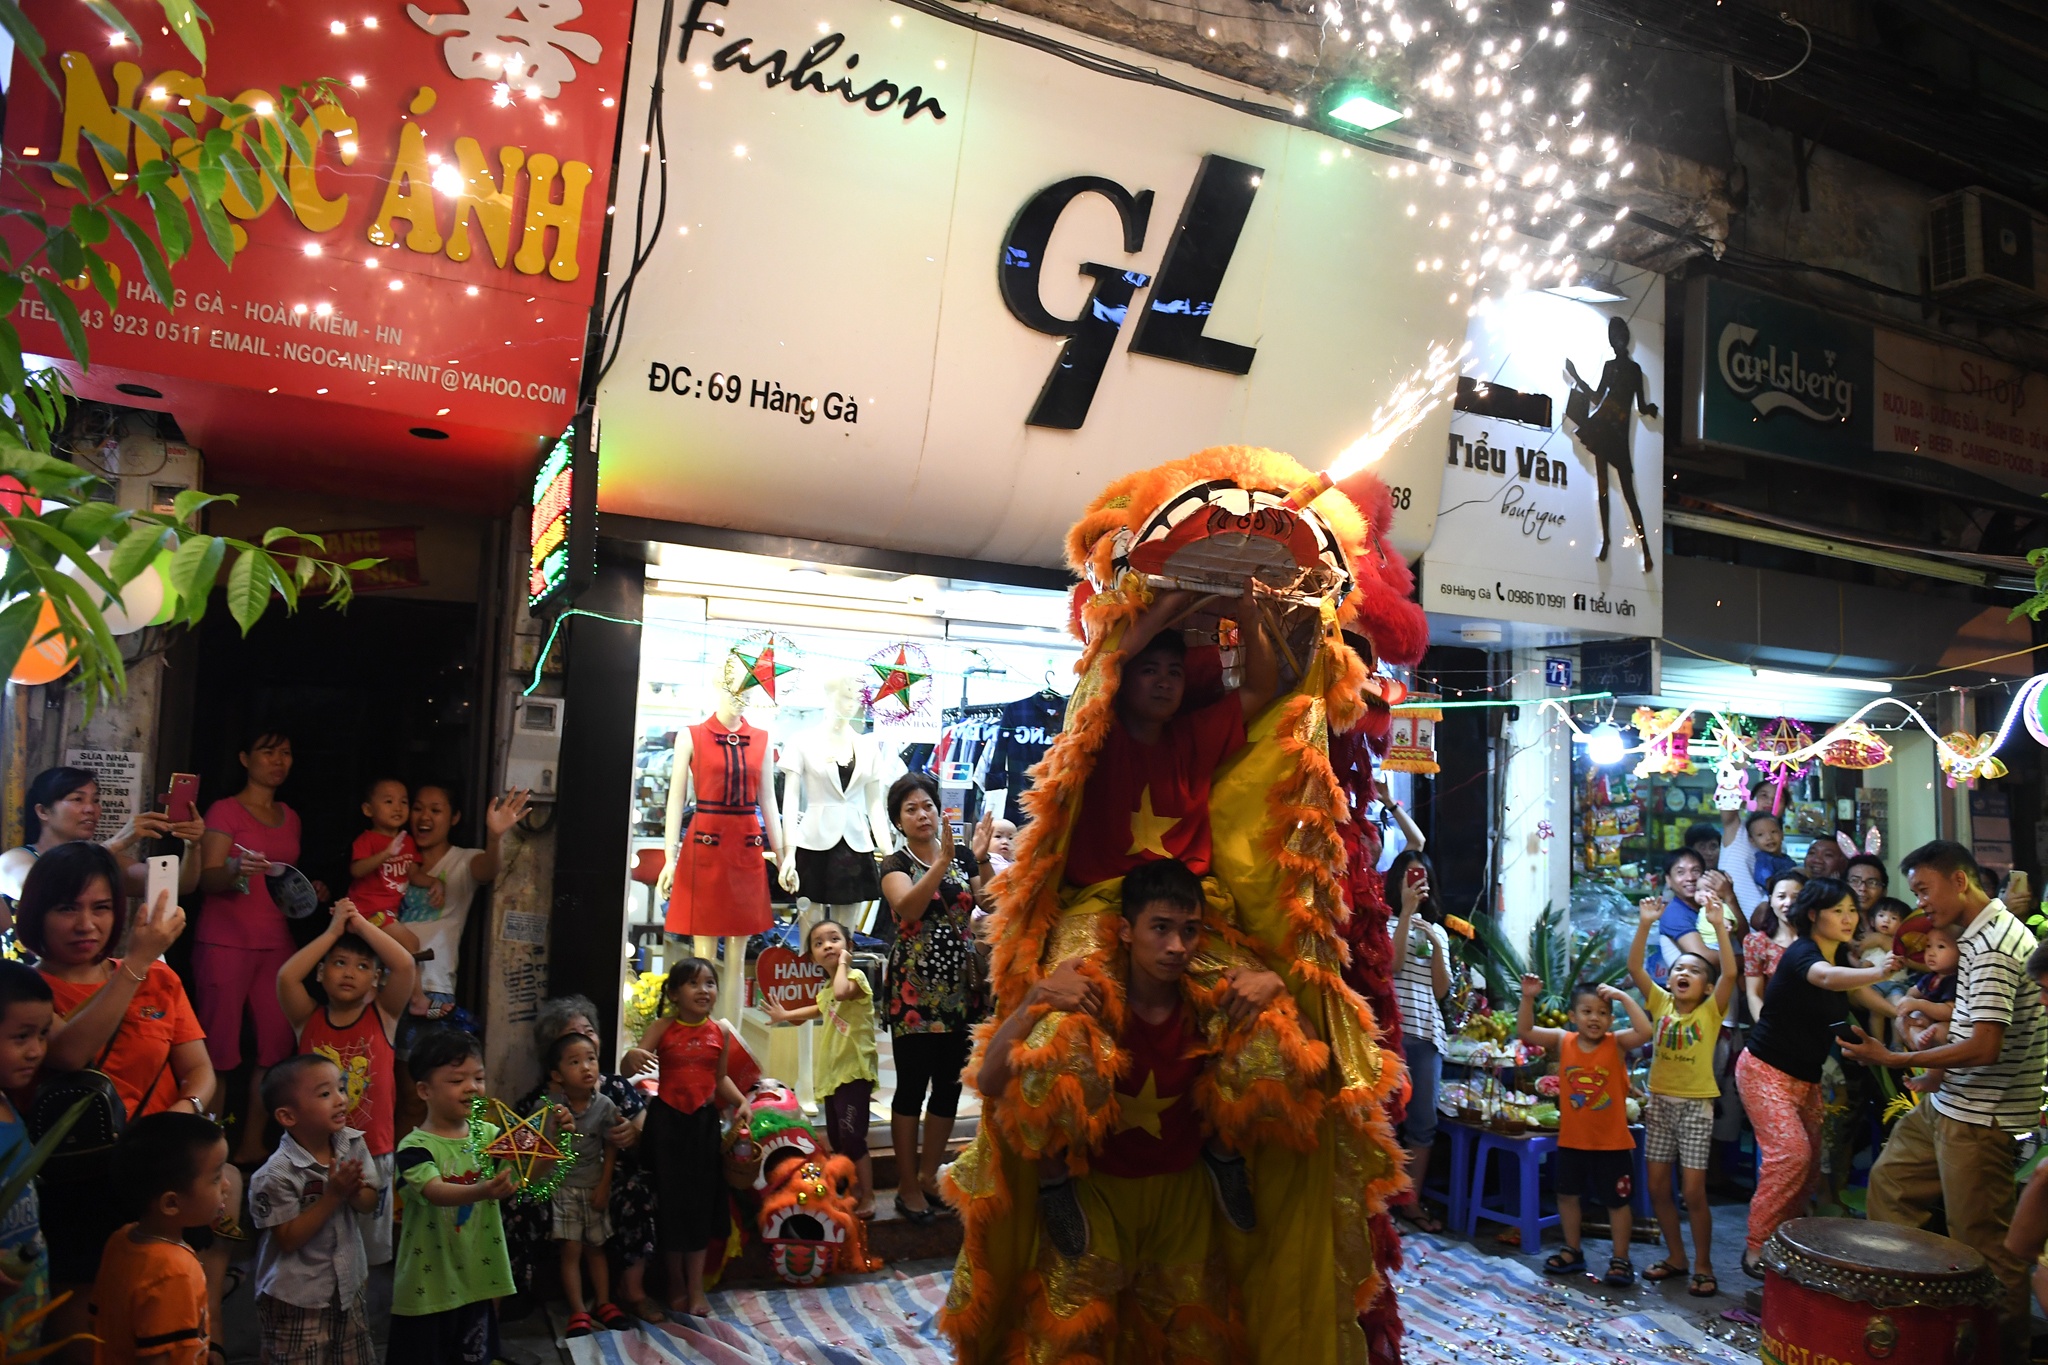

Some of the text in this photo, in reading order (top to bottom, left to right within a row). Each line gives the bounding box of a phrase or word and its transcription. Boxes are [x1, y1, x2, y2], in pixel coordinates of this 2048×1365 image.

[678, 0, 947, 120] Fashion
[367, 86, 593, 282] ÁNH
[112, 313, 149, 338] 923
[154, 320, 201, 346] 0511
[126, 280, 188, 308] HAG
[194, 290, 225, 315] GÀ
[245, 299, 302, 328] HOÀN
[375, 324, 403, 347] HN
[1718, 322, 1853, 418] Carlsberg
[1960, 360, 2026, 418] Shop
[707, 372, 742, 404] 69
[749, 378, 818, 425] Hàng
[823, 391, 859, 424] Gà
[1448, 430, 1568, 487] Tiểu Vân
[1893, 424, 1921, 447] WINE
[1928, 433, 1953, 455] BEER
[1961, 441, 2001, 466] CANNED
[2002, 451, 2035, 475] FOODS
[1500, 484, 1567, 542] boutique
[1440, 583, 1492, 601] 69 Hàng Gà
[1615, 598, 1636, 617] vân
[1549, 661, 1566, 684] 71
[106, 752, 130, 762] NHÀ
[768, 980, 803, 1002] MỚI
[774, 959, 824, 980] HÀNG
